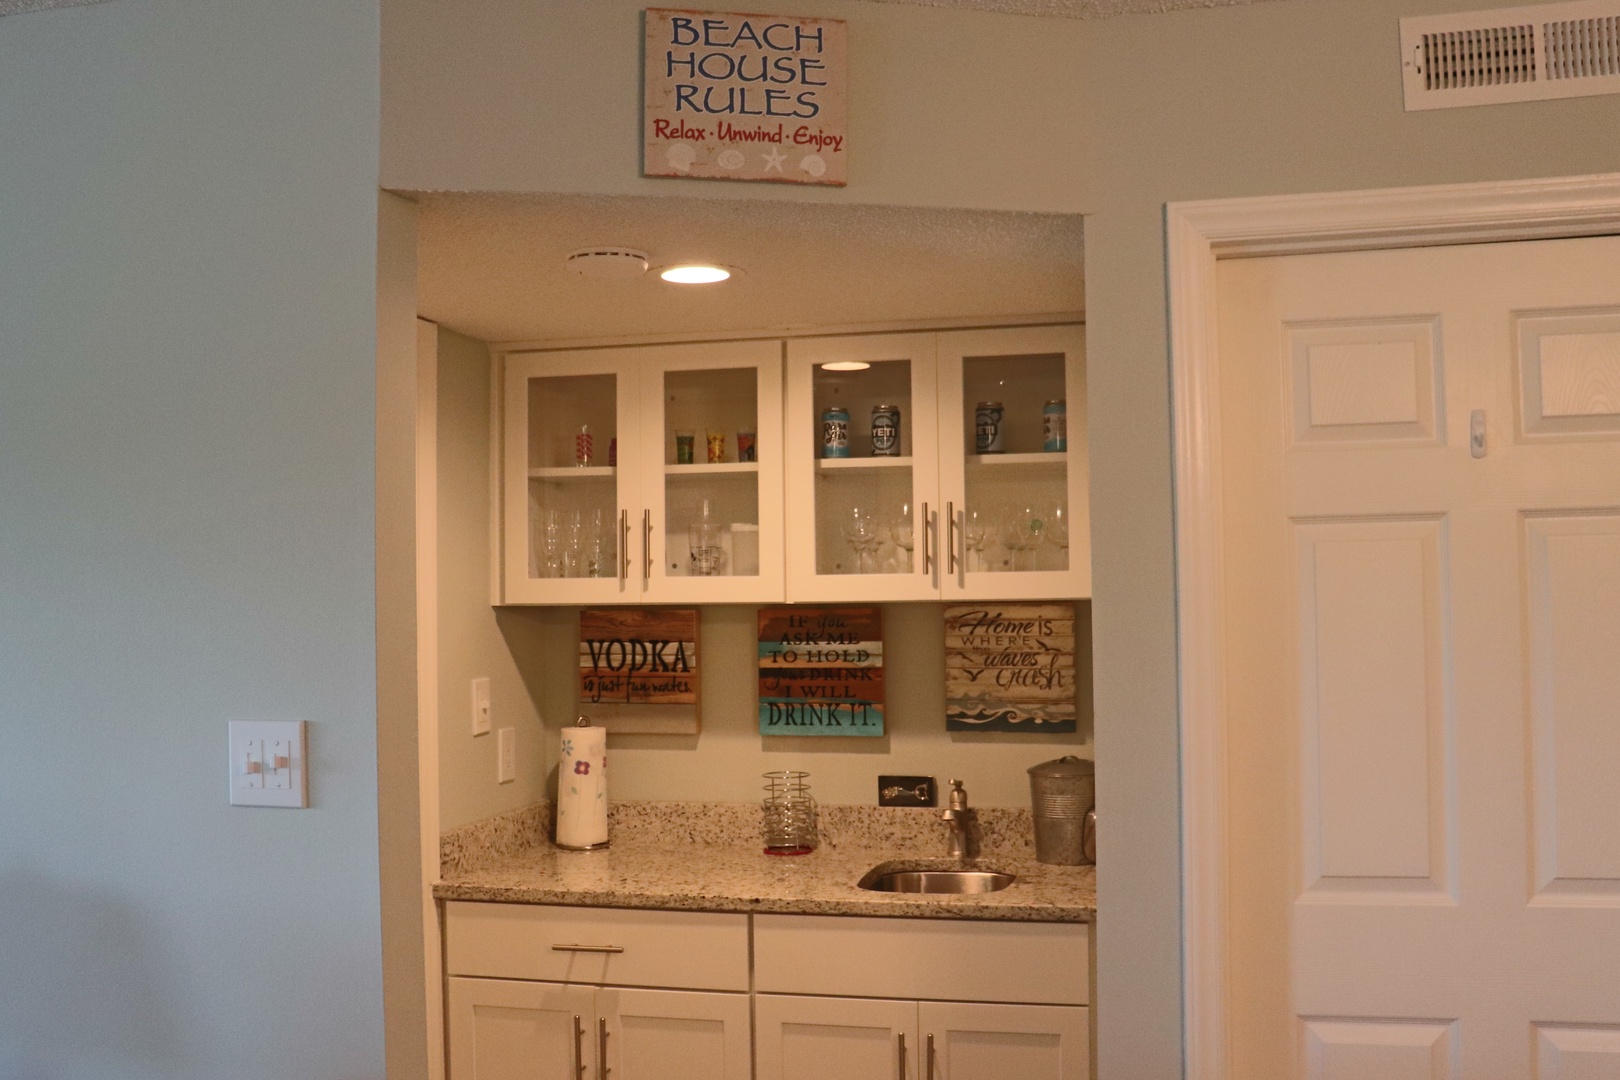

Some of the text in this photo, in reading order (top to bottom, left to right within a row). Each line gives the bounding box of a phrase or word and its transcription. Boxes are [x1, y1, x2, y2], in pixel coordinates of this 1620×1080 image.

[671, 17, 823, 53] BEACH
[666, 50, 827, 86] HOUSE
[675, 84, 820, 119] RULES
[653, 118, 843, 152] Relax Unwind Enjoy
[872, 427, 895, 437] YETI
[977, 425, 995, 435] ETI
[788, 615, 849, 638] IF you
[958, 611, 1035, 636] Home
[779, 628, 860, 645] ASK ME
[961, 636, 1031, 646] WHERE
[586, 639, 690, 673] VODKA
[768, 650, 870, 663] TO HOLD
[983, 646, 1041, 667] waves
[808, 667, 874, 681] DRINK
[583, 675, 595, 692] is
[592, 675, 623, 704] just
[626, 670, 650, 704] fun
[785, 685, 857, 698] I WILL
[767, 702, 876, 726] DRINK IT.
